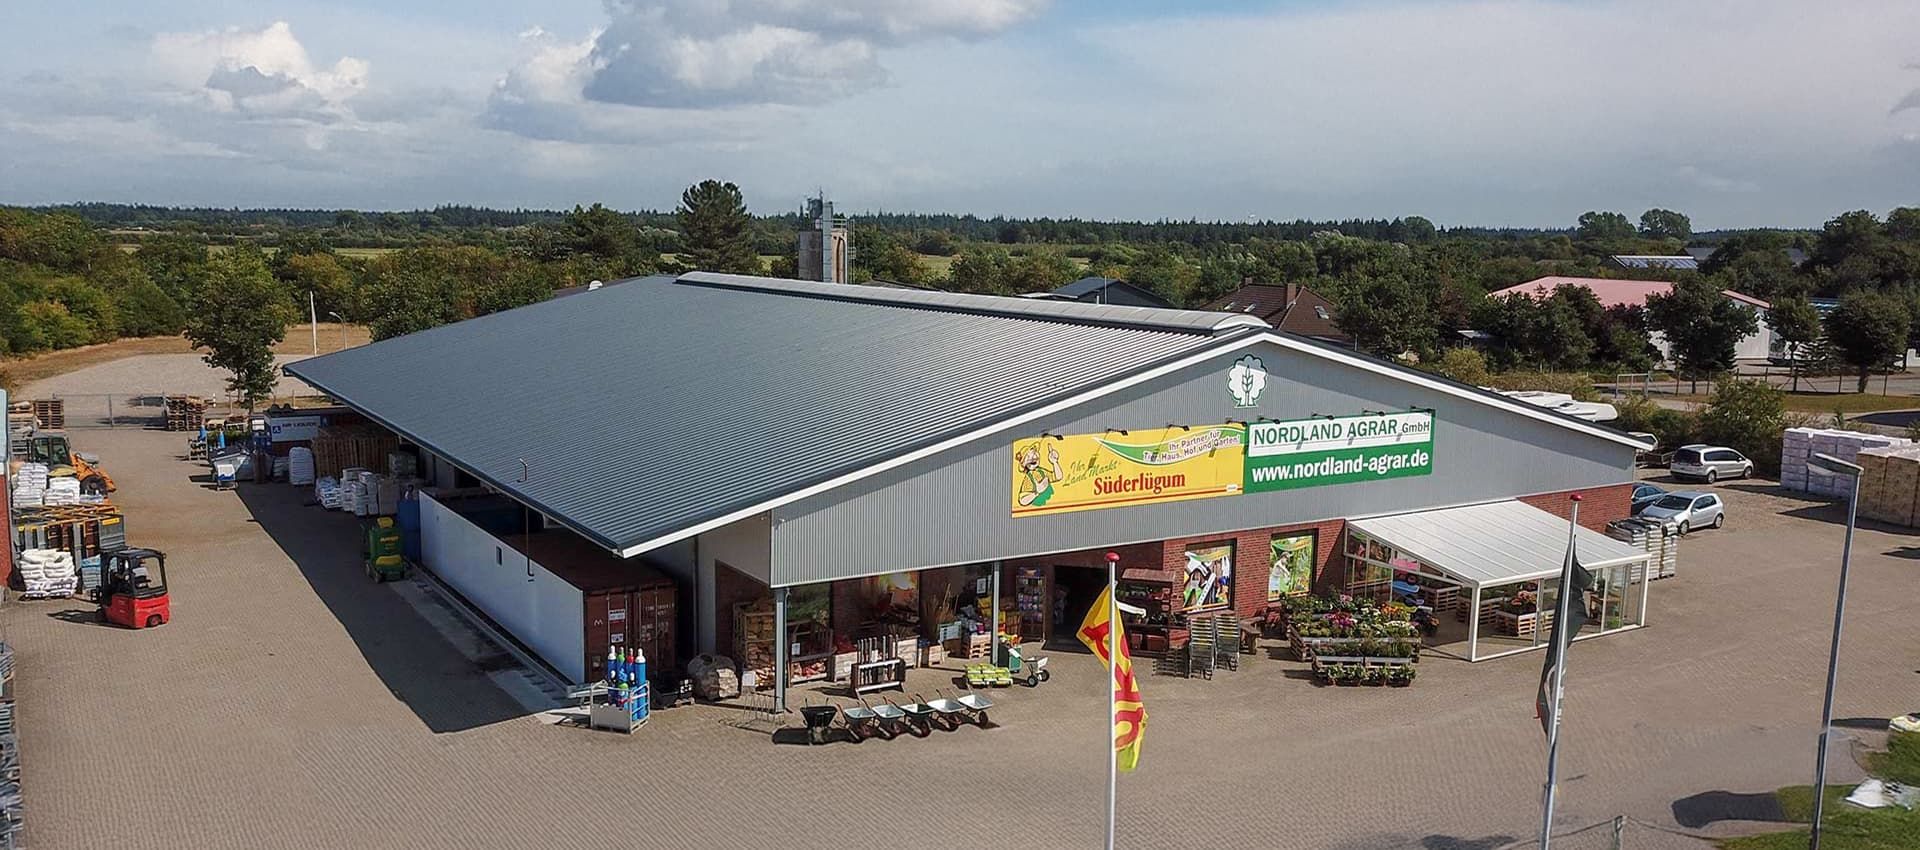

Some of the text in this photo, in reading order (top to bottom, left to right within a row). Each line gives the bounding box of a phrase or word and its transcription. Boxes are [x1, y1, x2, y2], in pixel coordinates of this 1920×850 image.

[1181, 435, 1207, 448] Partner
[1253, 419, 1430, 445] NORDLAND AGRAR GmbH
[1252, 449, 1429, 482] www.nordland-agrar.de
[1094, 472, 1185, 496] Süderlügum
